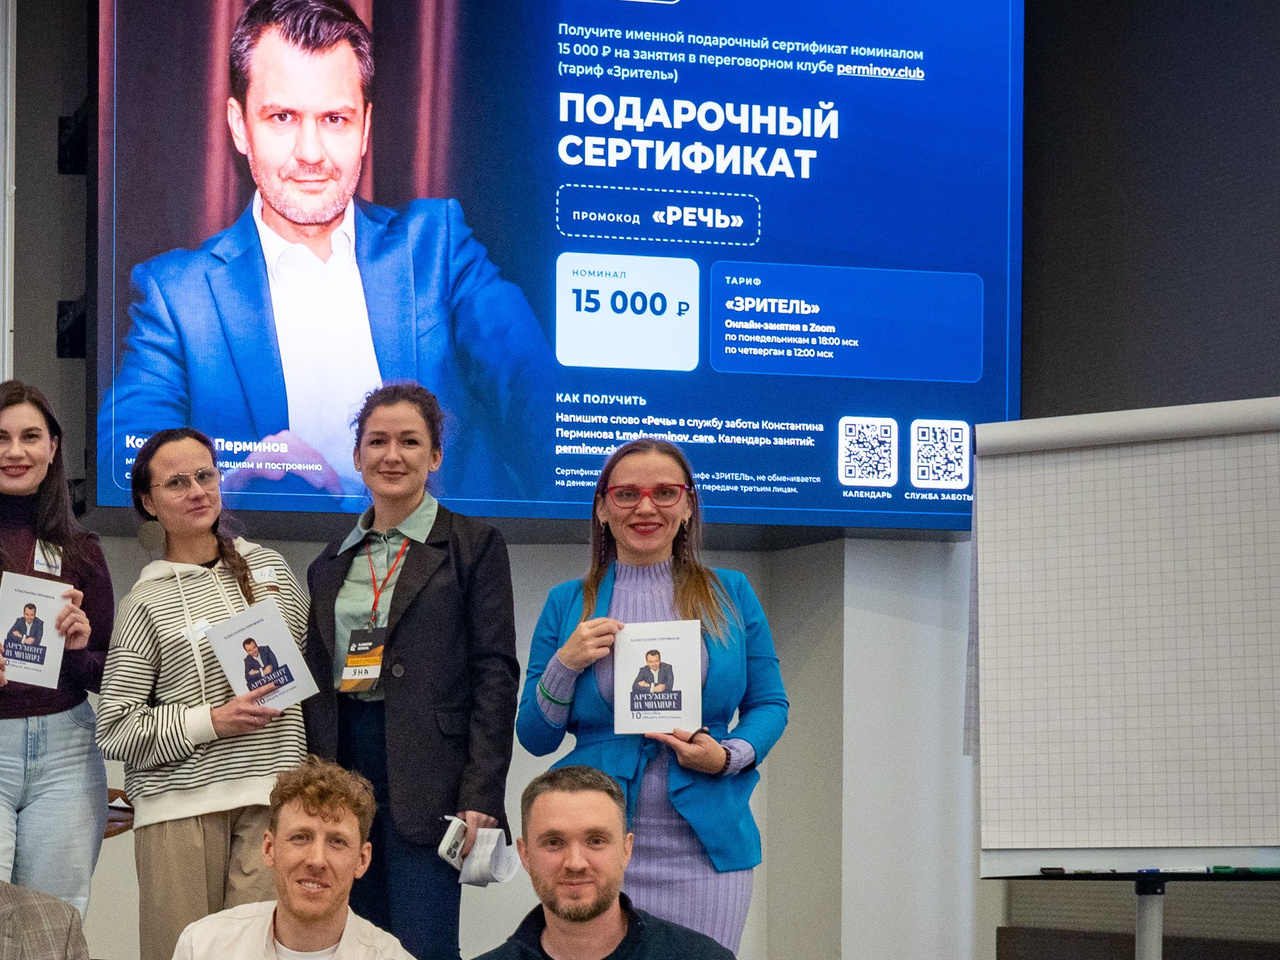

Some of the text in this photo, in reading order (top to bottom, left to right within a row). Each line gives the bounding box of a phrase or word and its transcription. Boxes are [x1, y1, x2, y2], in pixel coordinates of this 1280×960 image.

[559, 23, 923, 60] Получите именной подарочный сертификат номиналом
[558, 43, 570, 54] 15
[574, 44, 598, 57] 000
[615, 48, 629, 59] на
[633, 49, 685, 62] занятия
[689, 54, 695, 63] в
[700, 54, 793, 70] переговорном
[797, 60, 834, 74] клубе
[837, 63, 924, 81] perminov.club
[559, 62, 678, 83] (тариф «Зритель»)
[560, 92, 838, 139] ПОДАРОЧНЫЙ
[558, 134, 817, 179] СЕРТИФИКАТ
[573, 206, 743, 228] ПРОМОКОД «РЕЧЬ»
[573, 270, 625, 278] НОМИНАЛ
[725, 276, 761, 286] ТАРИФ
[572, 289, 600, 314] 15
[610, 290, 667, 317] 000
[725, 296, 820, 315] «ЗРИТЕЛЬ»
[725, 319, 835, 333] Онлайн-занятия в Zoom
[739, 334, 809, 345] понедельникам
[818, 336, 840, 346] 18:00
[738, 347, 784, 357] четвергам
[787, 349, 792, 357] в
[794, 348, 815, 358] 12:00
[817, 350, 833, 358] мск
[556, 393, 646, 405] КАК ПОЛУЧИТЬ
[556, 412, 608, 423] Напишите
[610, 416, 639, 424] слово
[642, 416, 677, 426] «Речь»
[687, 417, 723, 430] службу
[725, 418, 759, 429] заботы
[761, 420, 824, 431] Константина
[556, 428, 614, 440] Перминова
[718, 434, 771, 446] Календарь
[773, 437, 815, 446] занятий:
[215, 439, 288, 453] Перминов
[843, 490, 892, 499] КАЛЕНДАРЬ
[905, 492, 939, 500] СЛУЖБА
[352, 669, 369, 677] ЯНА
